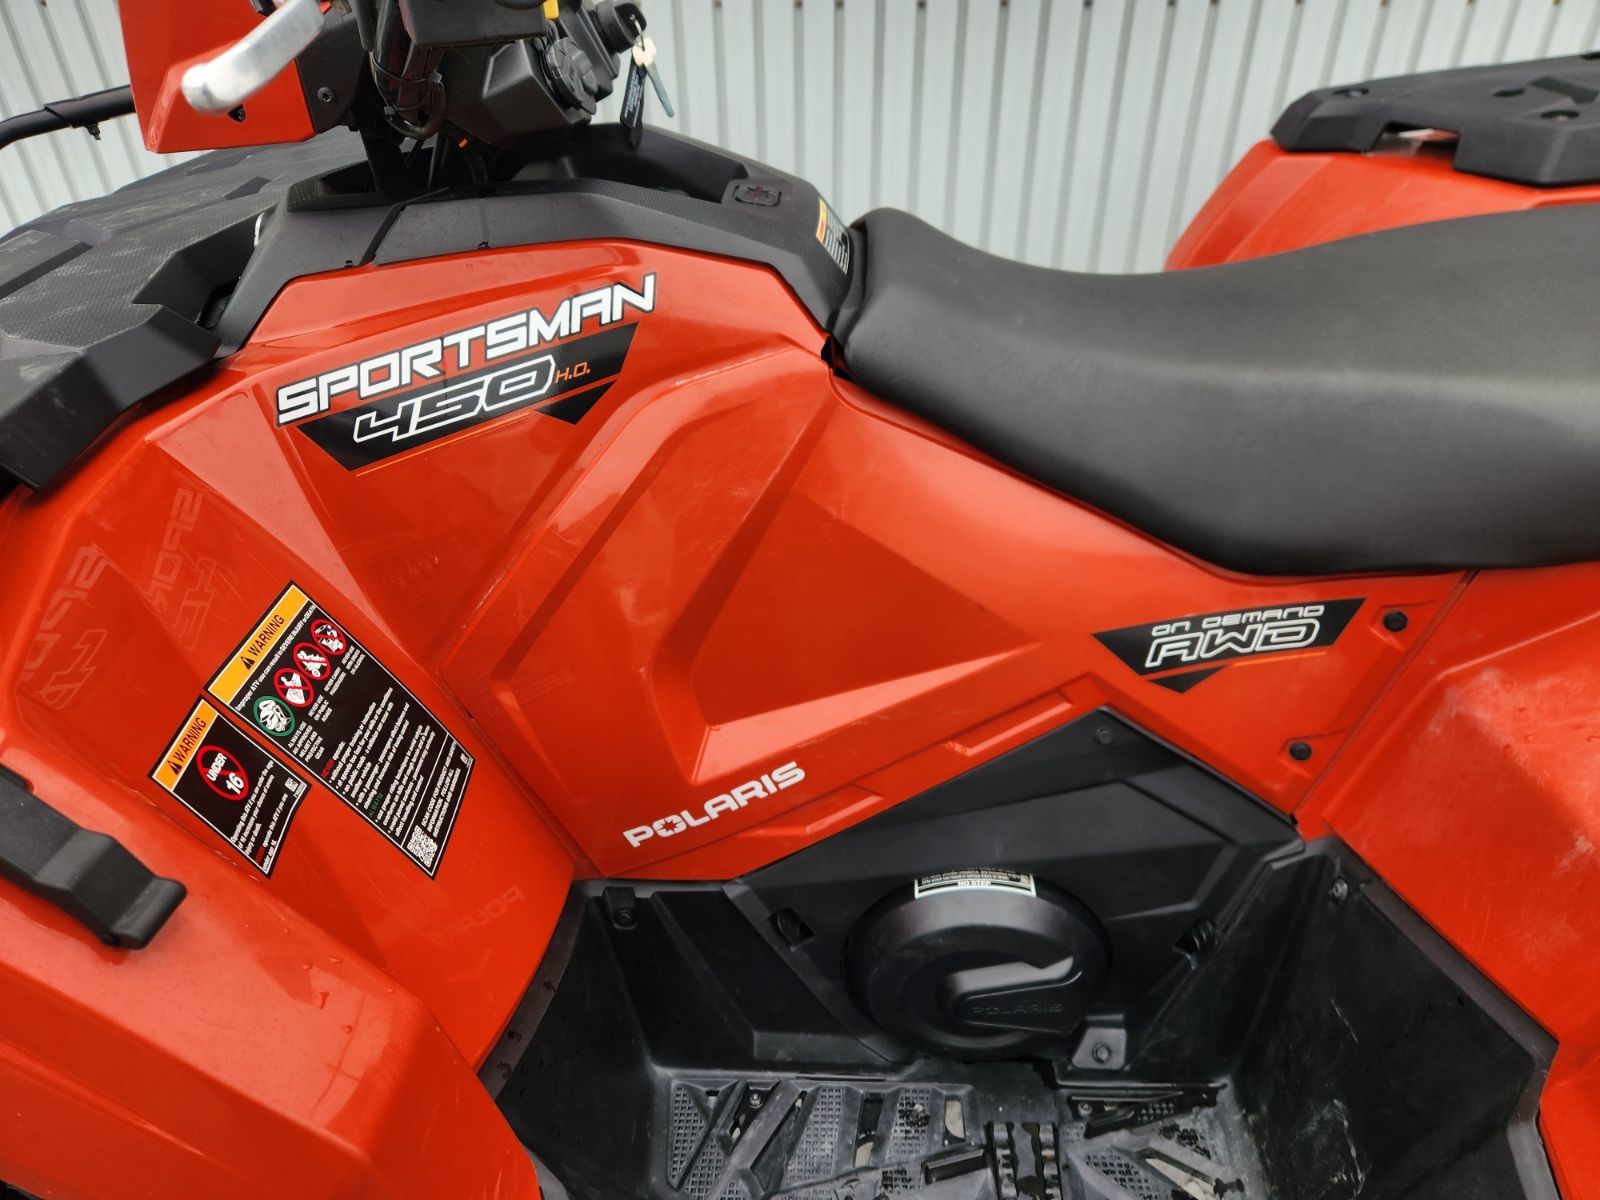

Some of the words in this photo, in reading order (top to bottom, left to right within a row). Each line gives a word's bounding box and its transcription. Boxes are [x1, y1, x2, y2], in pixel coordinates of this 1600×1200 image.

[276, 272, 656, 426] SPORTSMAN
[353, 355, 556, 443] 450
[556, 361, 591, 383] H.O.
[248, 614, 284, 655] WARNING
[1144, 618, 1321, 668] AWD
[1152, 620, 1191, 637] ON
[1202, 605, 1325, 628] DEMAND
[173, 717, 206, 761] WARNING
[206, 752, 226, 780] UNDER
[226, 772, 245, 796] 16
[623, 761, 806, 848] POLARIS
